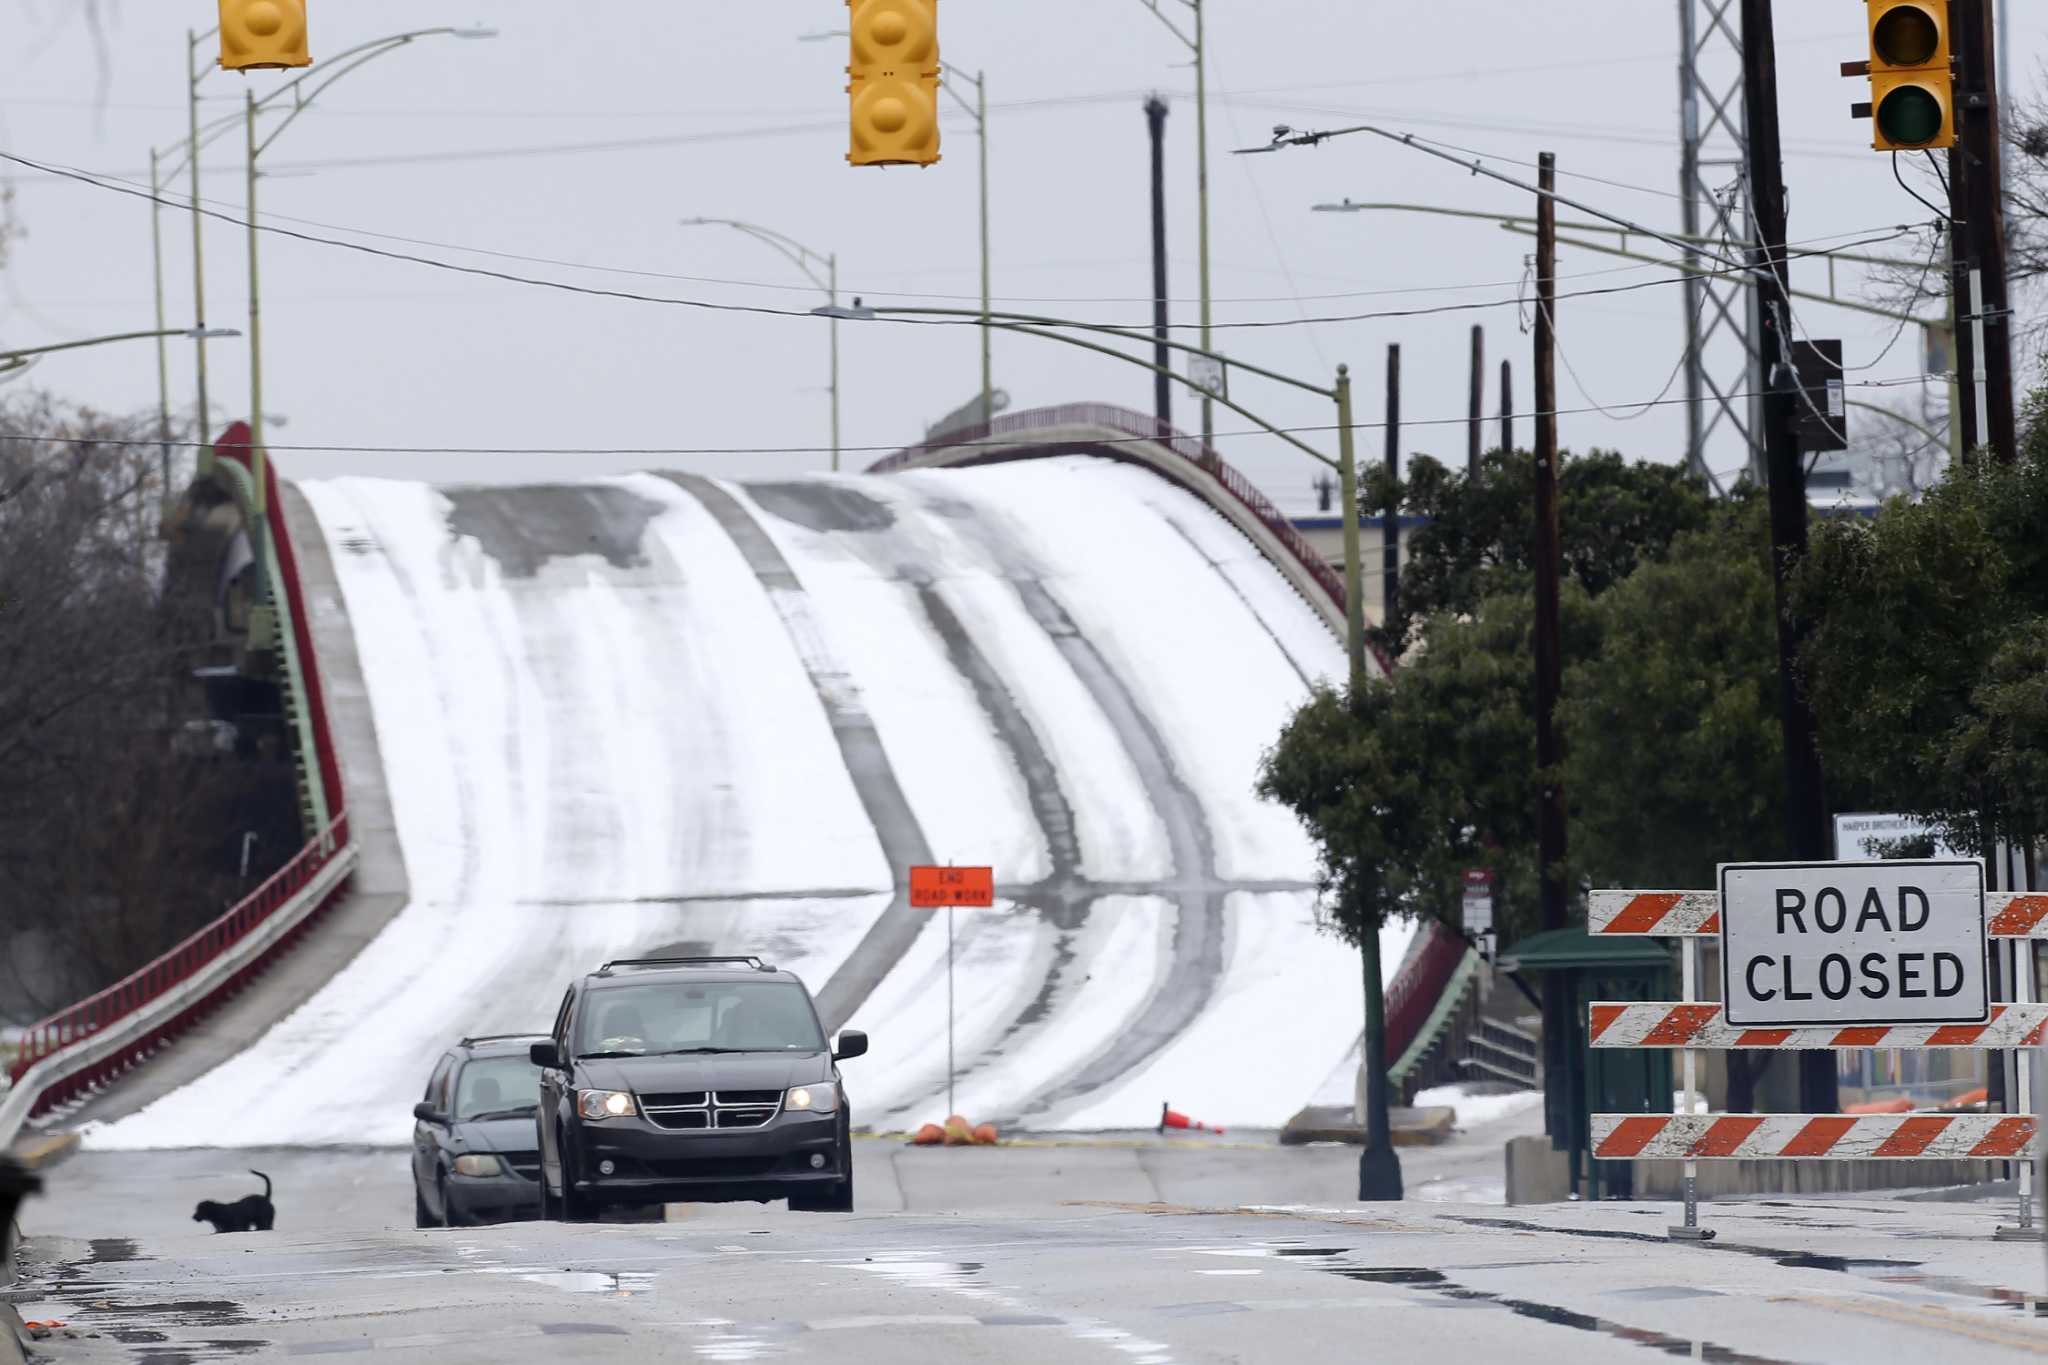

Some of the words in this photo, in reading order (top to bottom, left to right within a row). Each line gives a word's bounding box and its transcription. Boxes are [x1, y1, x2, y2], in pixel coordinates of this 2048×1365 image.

[939, 869, 963, 885] END
[914, 887, 947, 902] ROAD
[954, 887, 987, 902] WORK
[1775, 885, 1930, 934] ROAD
[1745, 952, 1965, 1002] CLOSED
